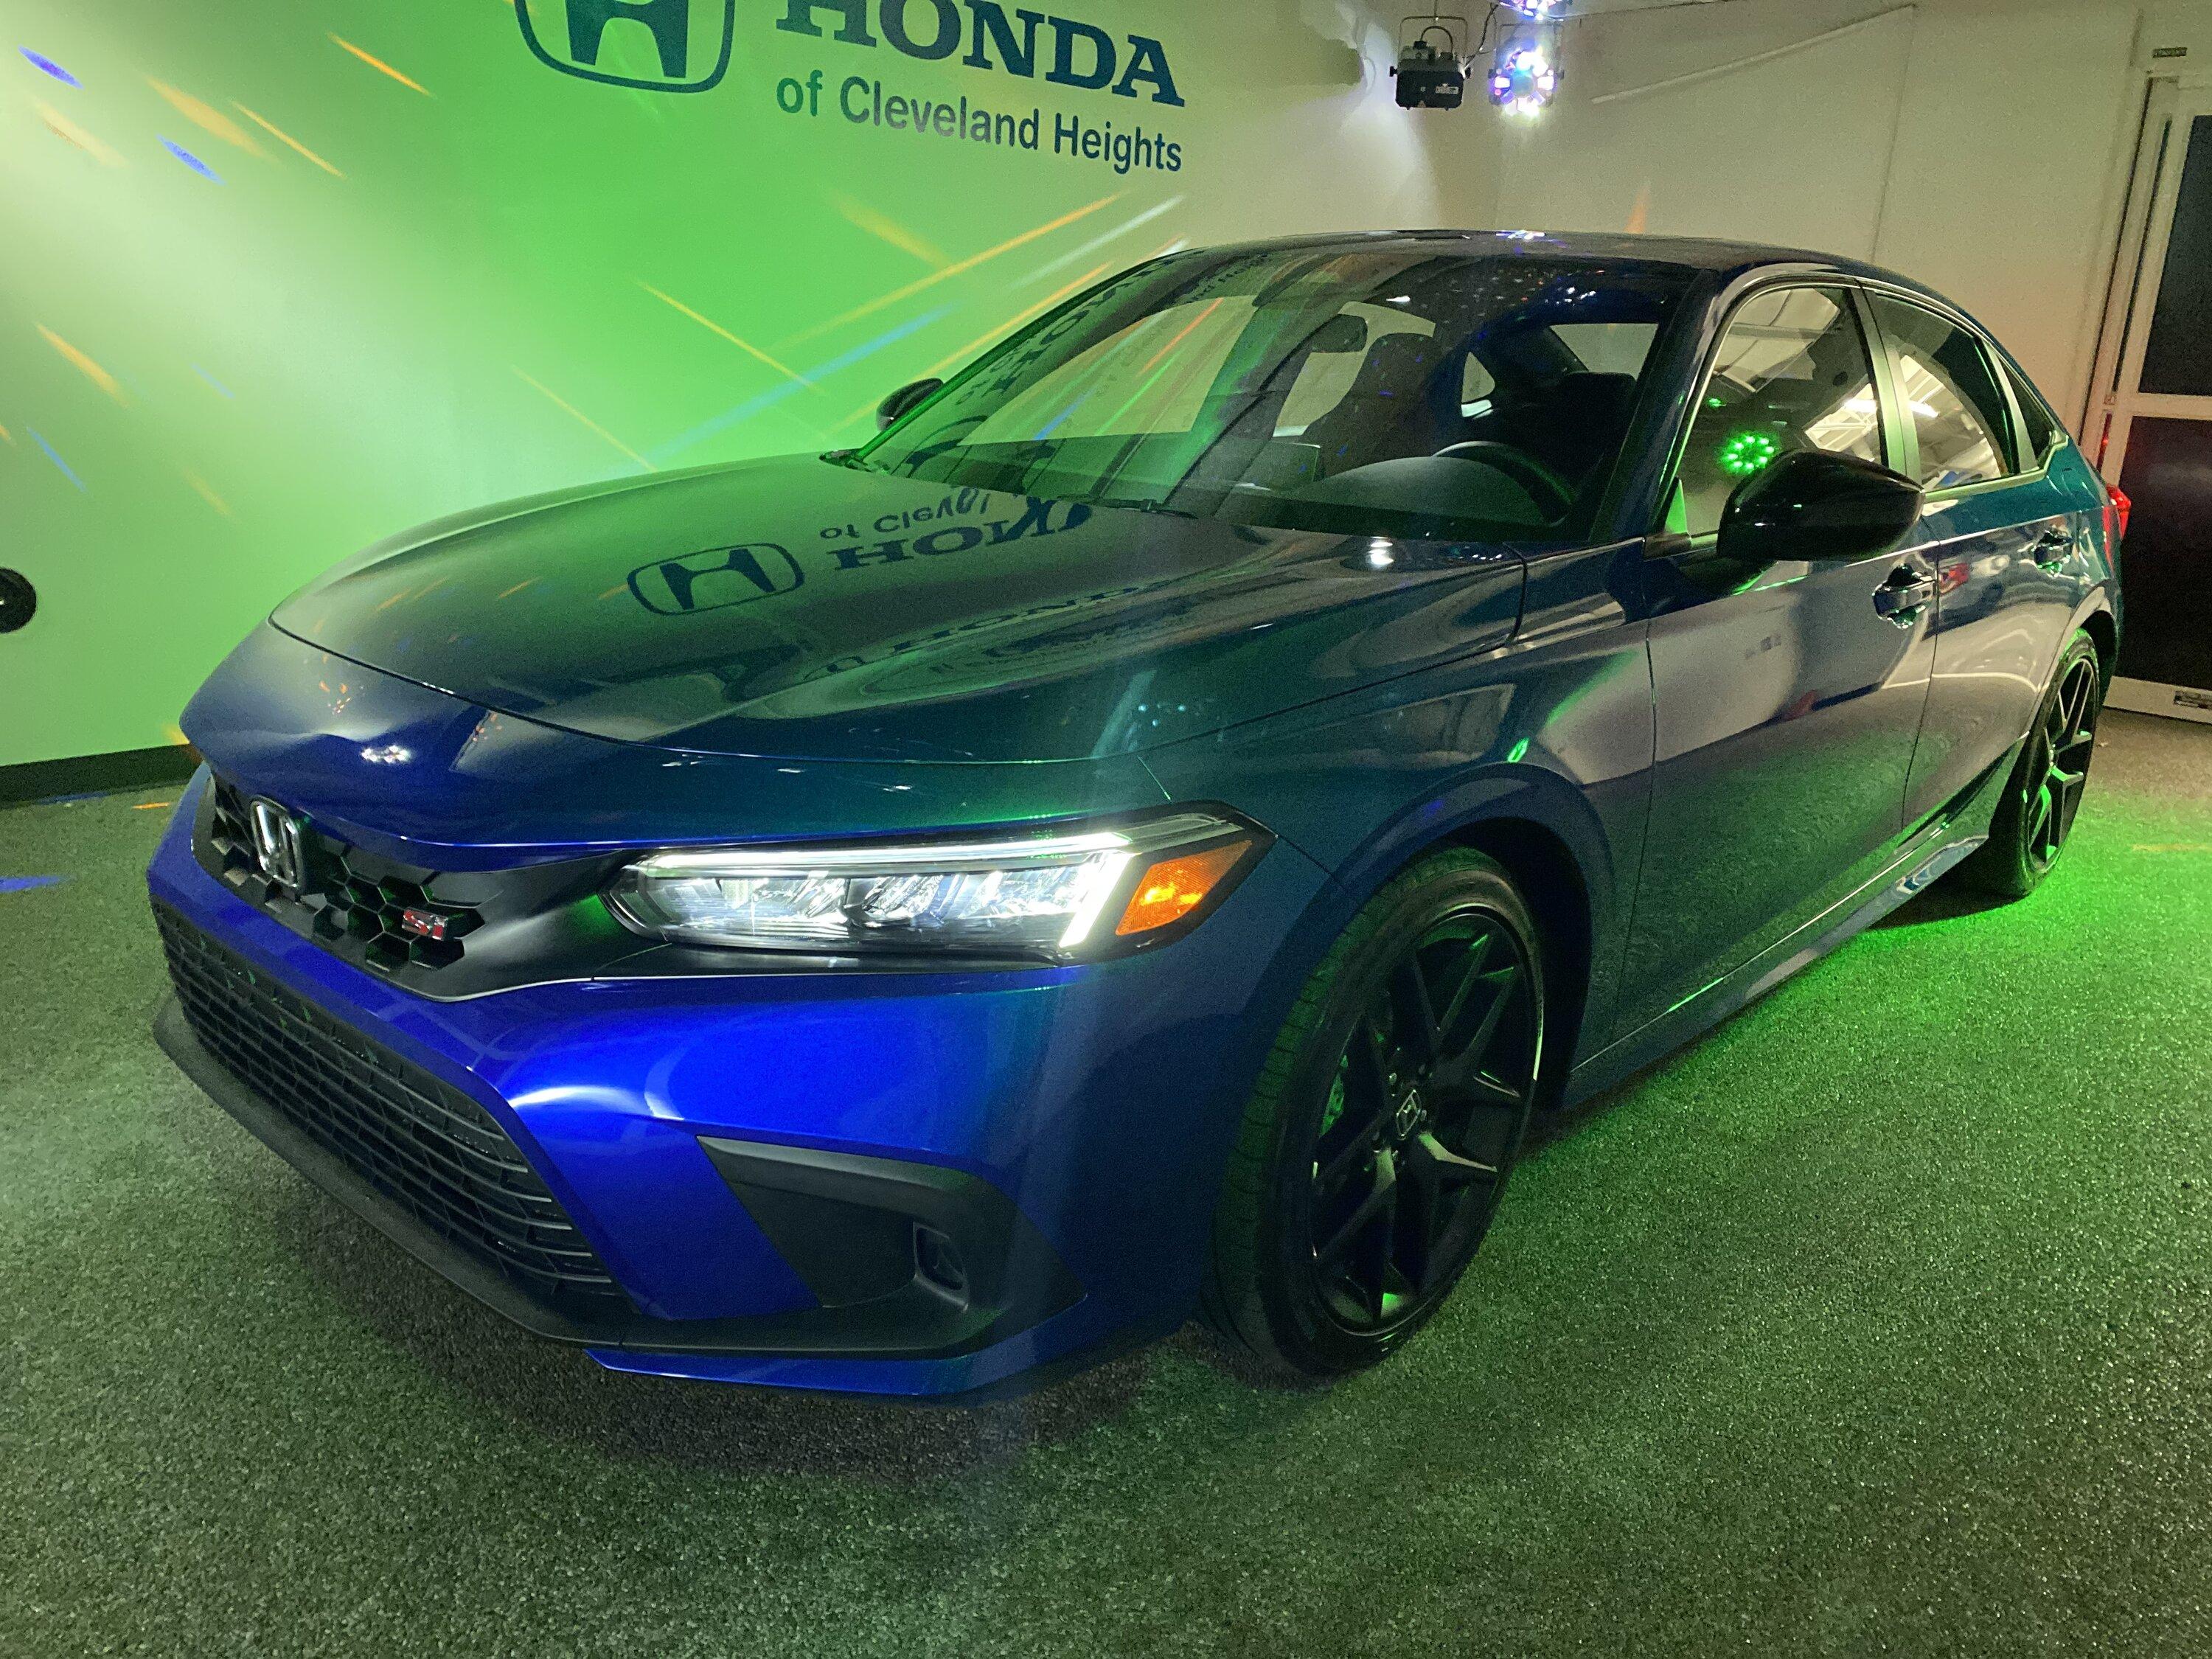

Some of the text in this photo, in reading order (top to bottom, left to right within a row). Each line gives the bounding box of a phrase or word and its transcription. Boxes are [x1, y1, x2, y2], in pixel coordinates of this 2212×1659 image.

[776, 69, 1183, 175] of Cleveland Heights
